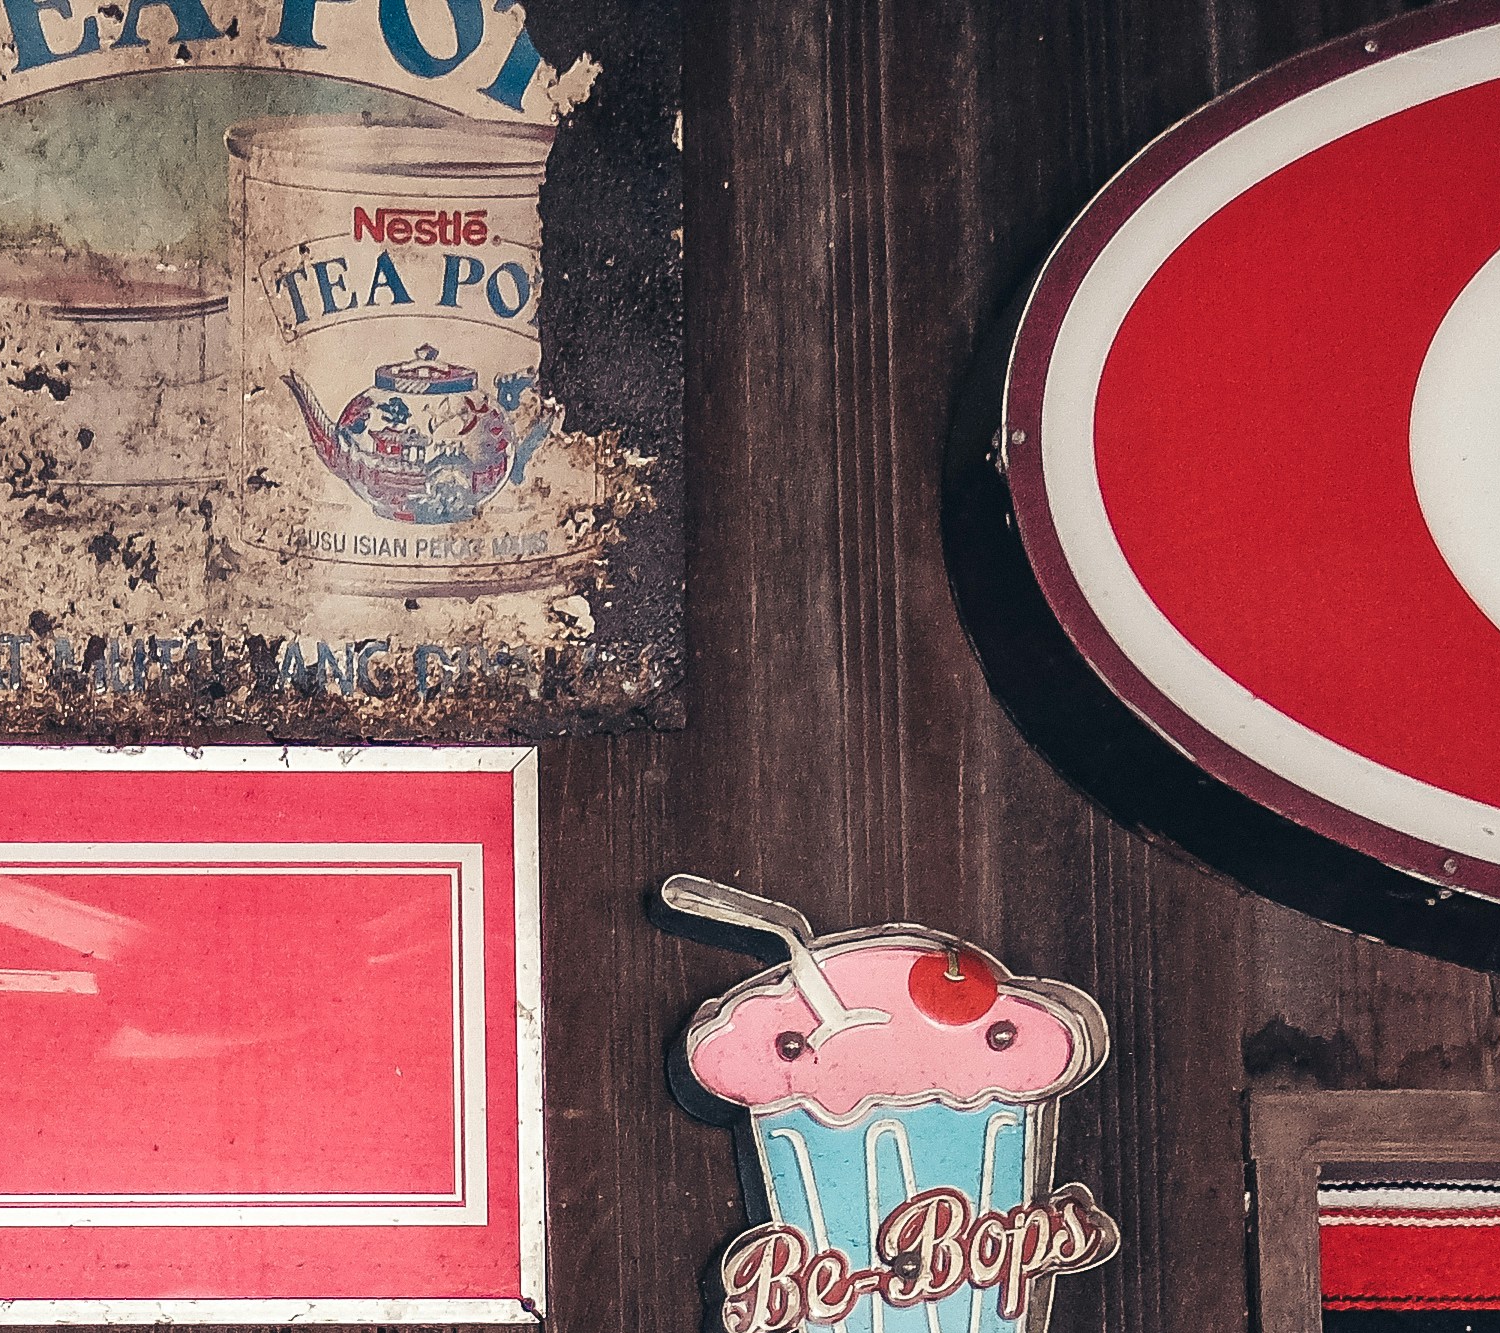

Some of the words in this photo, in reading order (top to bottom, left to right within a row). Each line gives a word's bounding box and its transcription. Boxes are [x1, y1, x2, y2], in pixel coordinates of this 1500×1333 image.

[275, 249, 416, 326] TEA
[436, 253, 539, 328] PO
[353, 535, 408, 559] ISIAN
